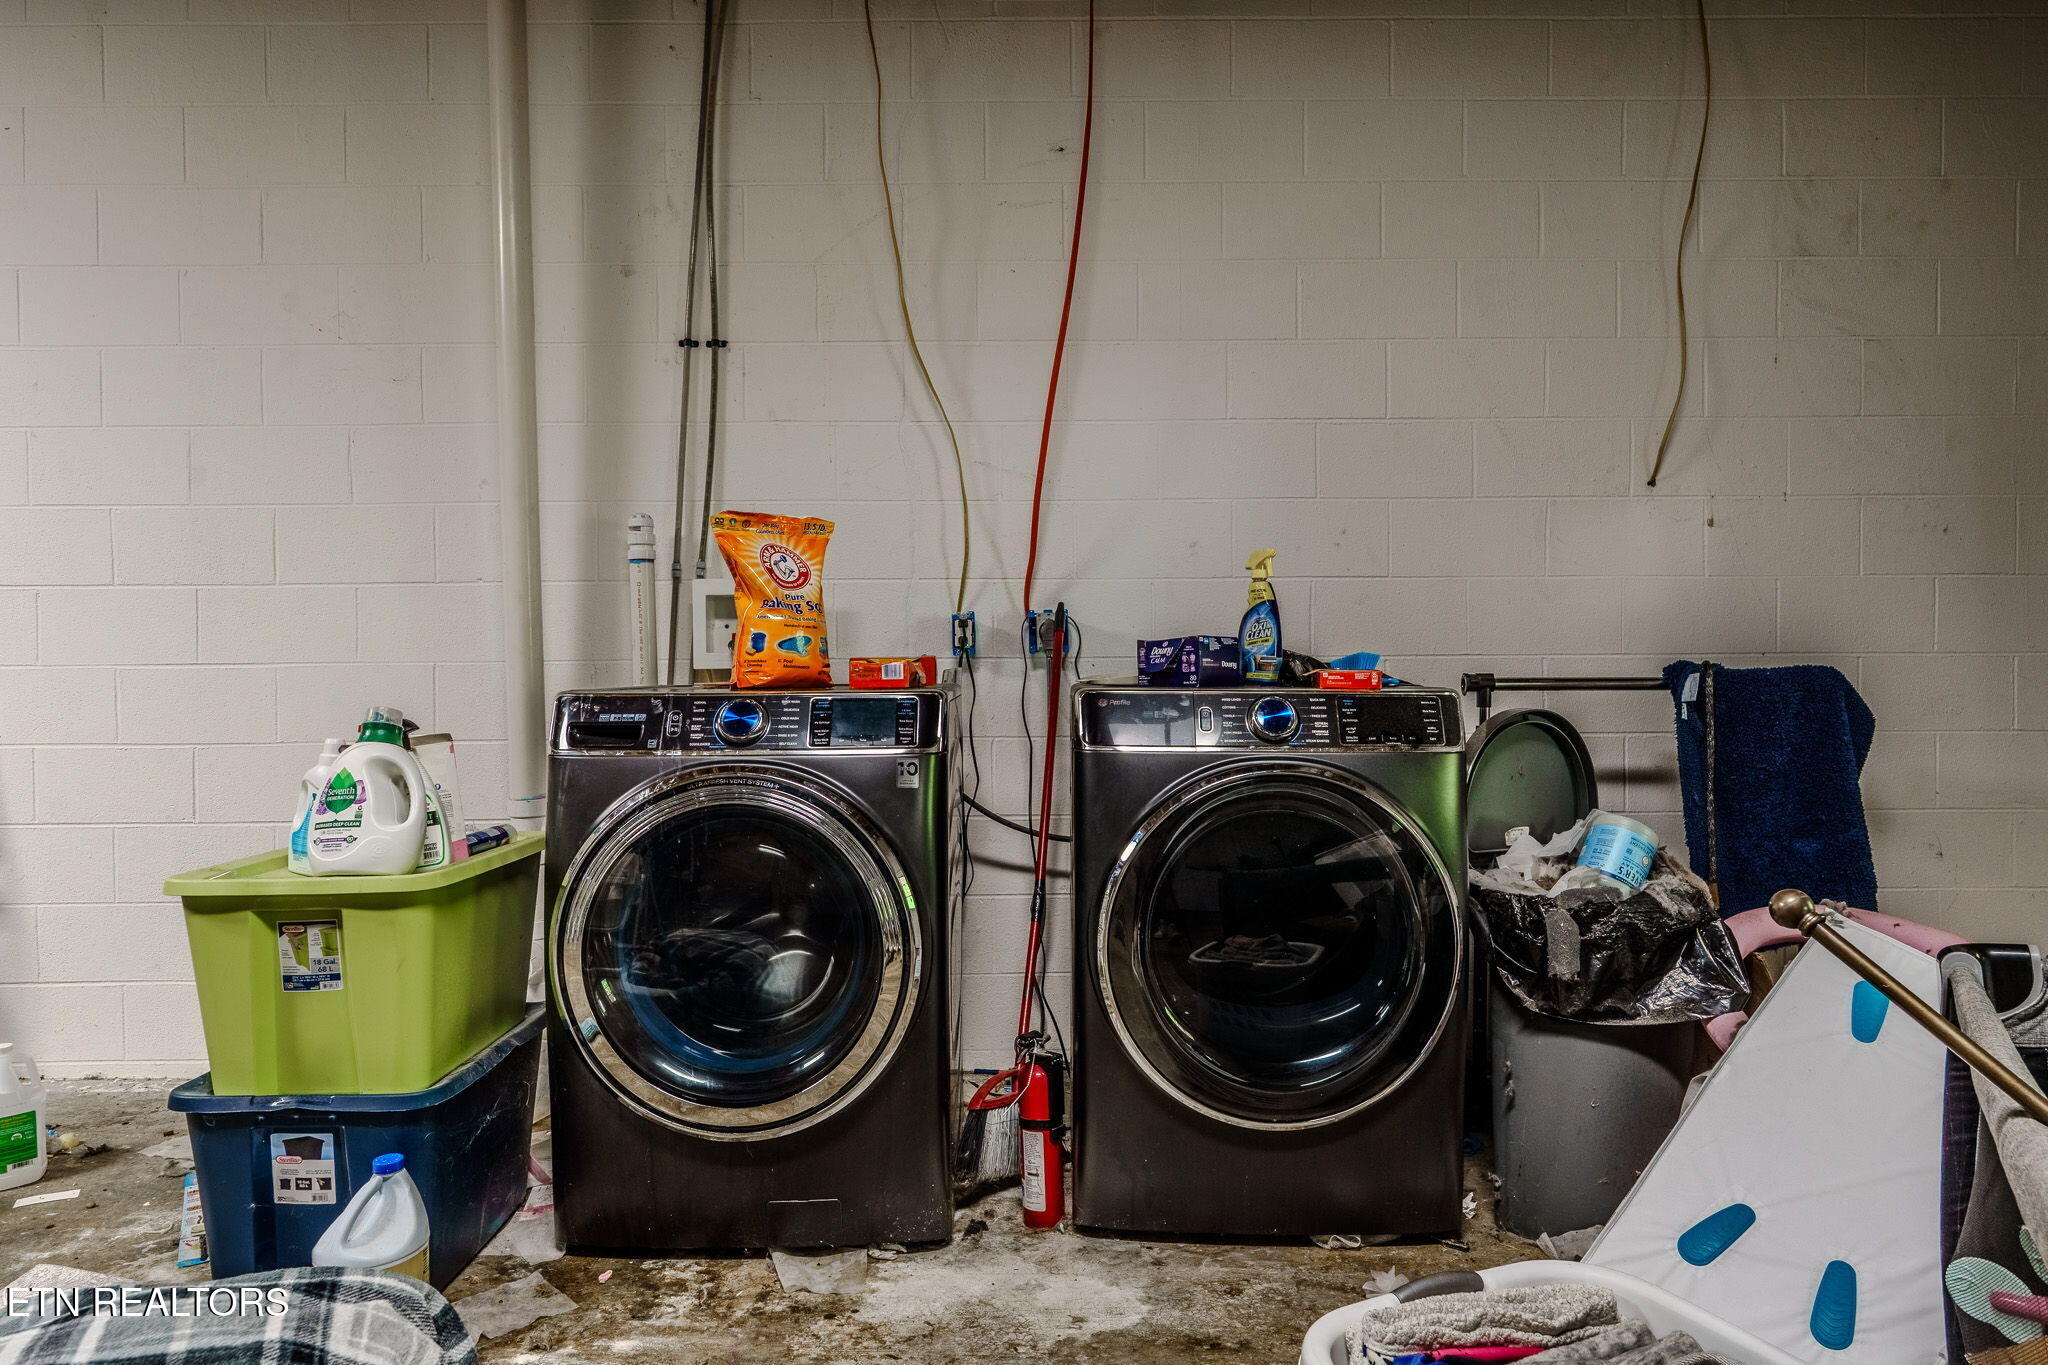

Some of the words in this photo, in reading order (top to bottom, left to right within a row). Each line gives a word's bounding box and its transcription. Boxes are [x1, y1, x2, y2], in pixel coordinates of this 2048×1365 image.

[803, 522, 816, 530] 13.5
[817, 523, 827, 532] lb.
[763, 550, 772, 570] ARM
[776, 545, 807, 573] HAMMER
[760, 597, 803, 614] Baking
[1252, 621, 1266, 631] OXI
[1247, 629, 1271, 640] CLEAN
[1151, 647, 1173, 656] Downy
[1221, 661, 1237, 669] Downy
[897, 761, 919, 777] 10
[328, 787, 355, 795] Seventh
[1617, 866, 1641, 886] YER'S
